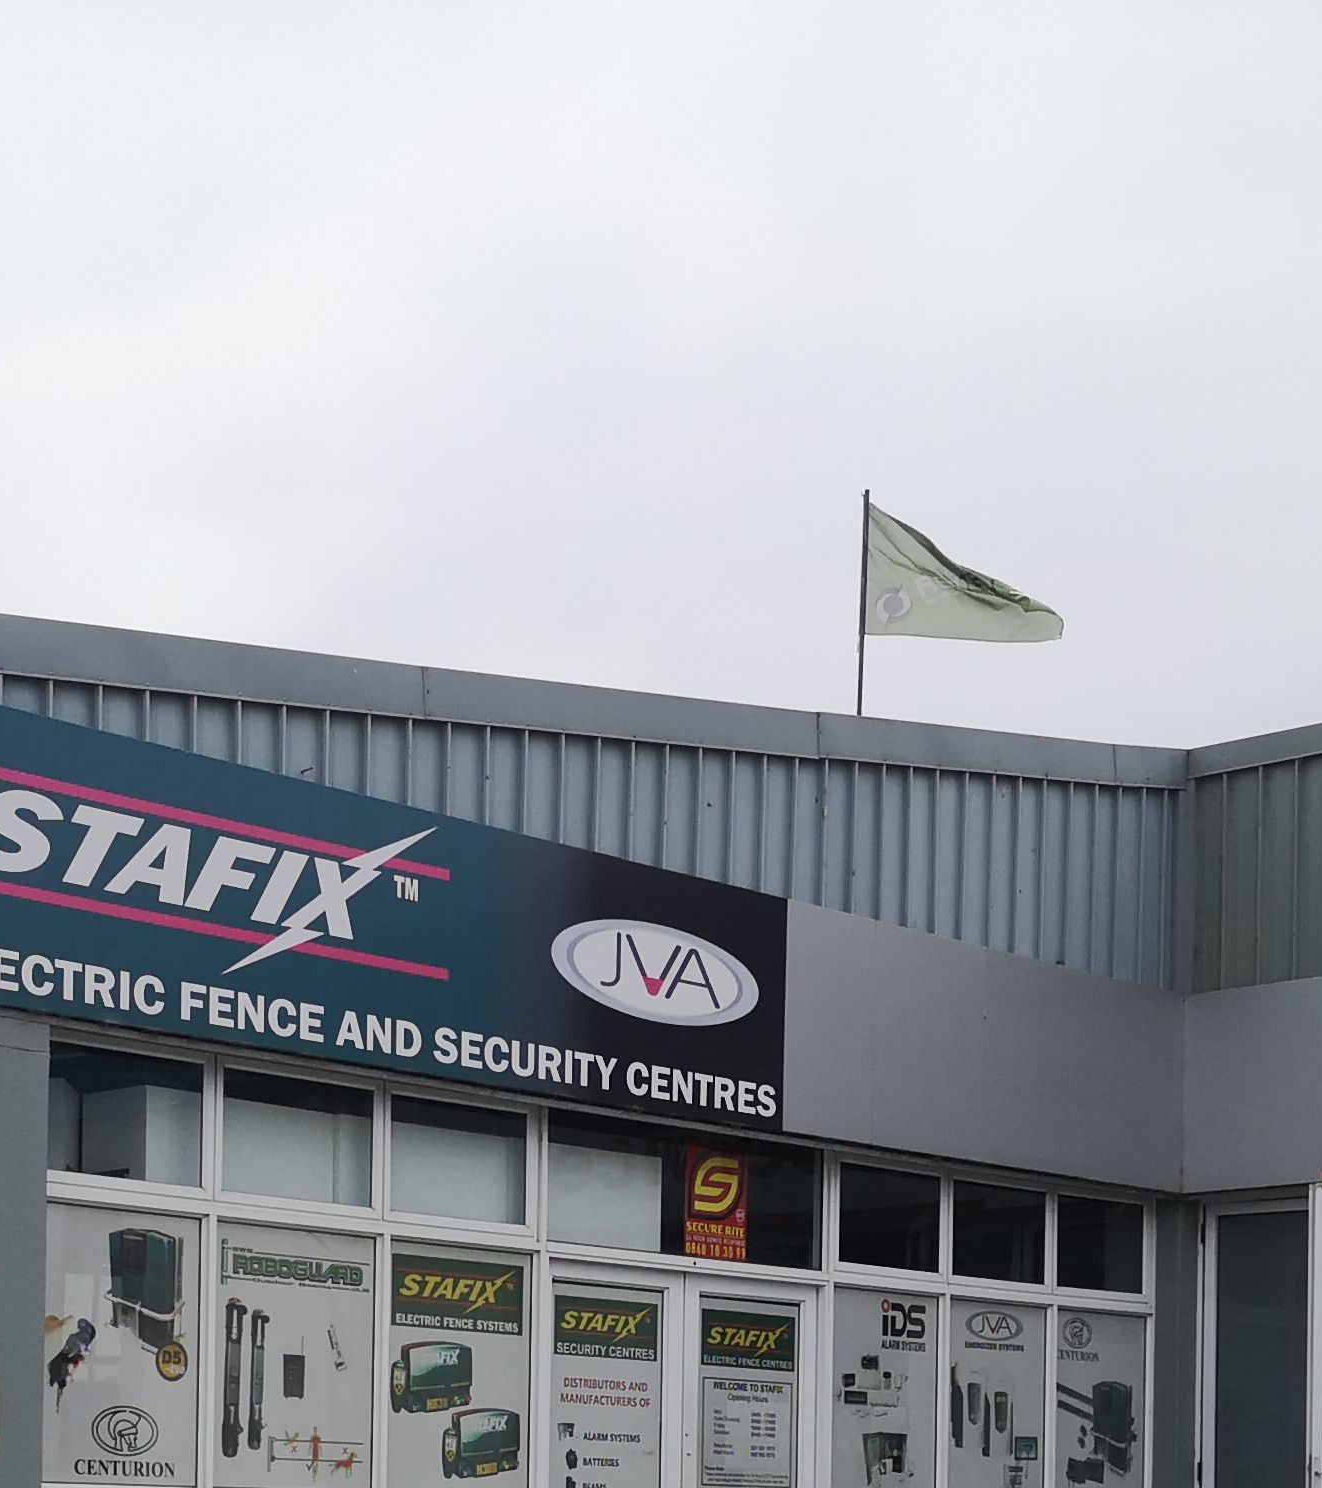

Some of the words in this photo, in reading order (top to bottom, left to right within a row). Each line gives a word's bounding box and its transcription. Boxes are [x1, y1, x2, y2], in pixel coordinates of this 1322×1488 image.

[599, 932, 720, 1010] JVA
[181, 982, 326, 1044] FENCE
[335, 1012, 424, 1059] AND
[432, 1027, 618, 1093] SECURITY
[627, 1061, 778, 1119] CENTRES
[686, 1221, 724, 1235] SECURE
[725, 1226, 745, 1239] RITE
[232, 1253, 364, 1287] ROBOGUARD
[399, 1273, 507, 1307] STAFIX
[395, 1312, 441, 1327] ELECTRIC
[443, 1316, 475, 1330] FENCE
[477, 1320, 519, 1333] SYSTEMS
[561, 1309, 646, 1337] STAFIX
[978, 1314, 1013, 1335] JVA
[707, 1325, 782, 1351] STAFIX
[161, 1349, 182, 1365] D5
[557, 1341, 607, 1356] SECURITY
[608, 1345, 655, 1360] CENTRES
[703, 1354, 737, 1366] ELECTRIC
[738, 1357, 761, 1367] FENCE
[563, 1377, 627, 1391] DISTRIBUTORS
[628, 1381, 648, 1392] AND
[713, 1381, 748, 1392] WELCOME
[749, 1383, 759, 1392] TO
[560, 1393, 638, 1407] MANUFACTURERS
[639, 1397, 651, 1408] OF
[583, 1431, 609, 1442] ALARM
[610, 1433, 641, 1443] SYSTEMS
[73, 1458, 176, 1478] CENTURION
[583, 1457, 619, 1468] BATTERIES
